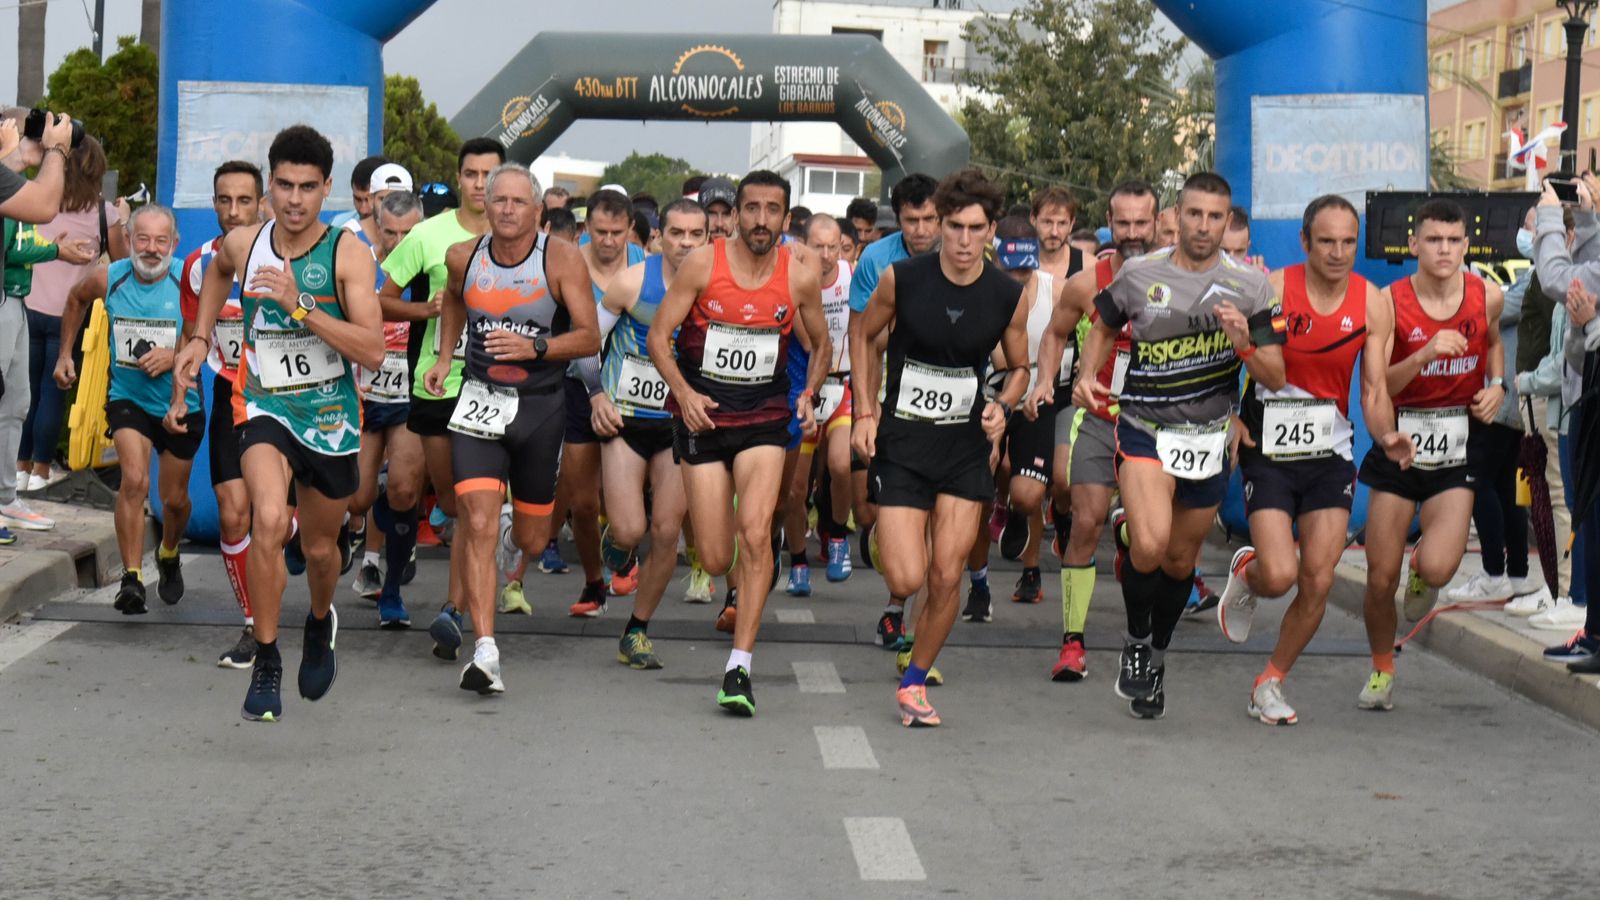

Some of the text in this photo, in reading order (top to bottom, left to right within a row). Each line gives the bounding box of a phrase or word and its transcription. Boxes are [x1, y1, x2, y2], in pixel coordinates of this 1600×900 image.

[774, 65, 840, 85] ESTRECHO DE
[616, 76, 638, 99] BTT
[649, 74, 763, 103] ALCORNOCALES
[779, 84, 834, 102] GIBRALTAR
[779, 102, 836, 113] LOS BARRIOS
[499, 94, 549, 149] ALCORNOCALES
[854, 97, 907, 148] ALCORNOCALES
[1266, 142, 1420, 174] DECATHLON
[476, 318, 540, 338] SÁNCHEZ
[289, 338, 323, 349] ANTONIO
[280, 354, 311, 378] 16
[715, 347, 757, 371] 500
[370, 369, 403, 389] 274
[628, 376, 666, 401] 308
[910, 387, 953, 412] 289
[463, 400, 500, 425] 242
[1275, 422, 1315, 446] 245
[1411, 432, 1449, 455] 244
[1169, 448, 1210, 472] 297
